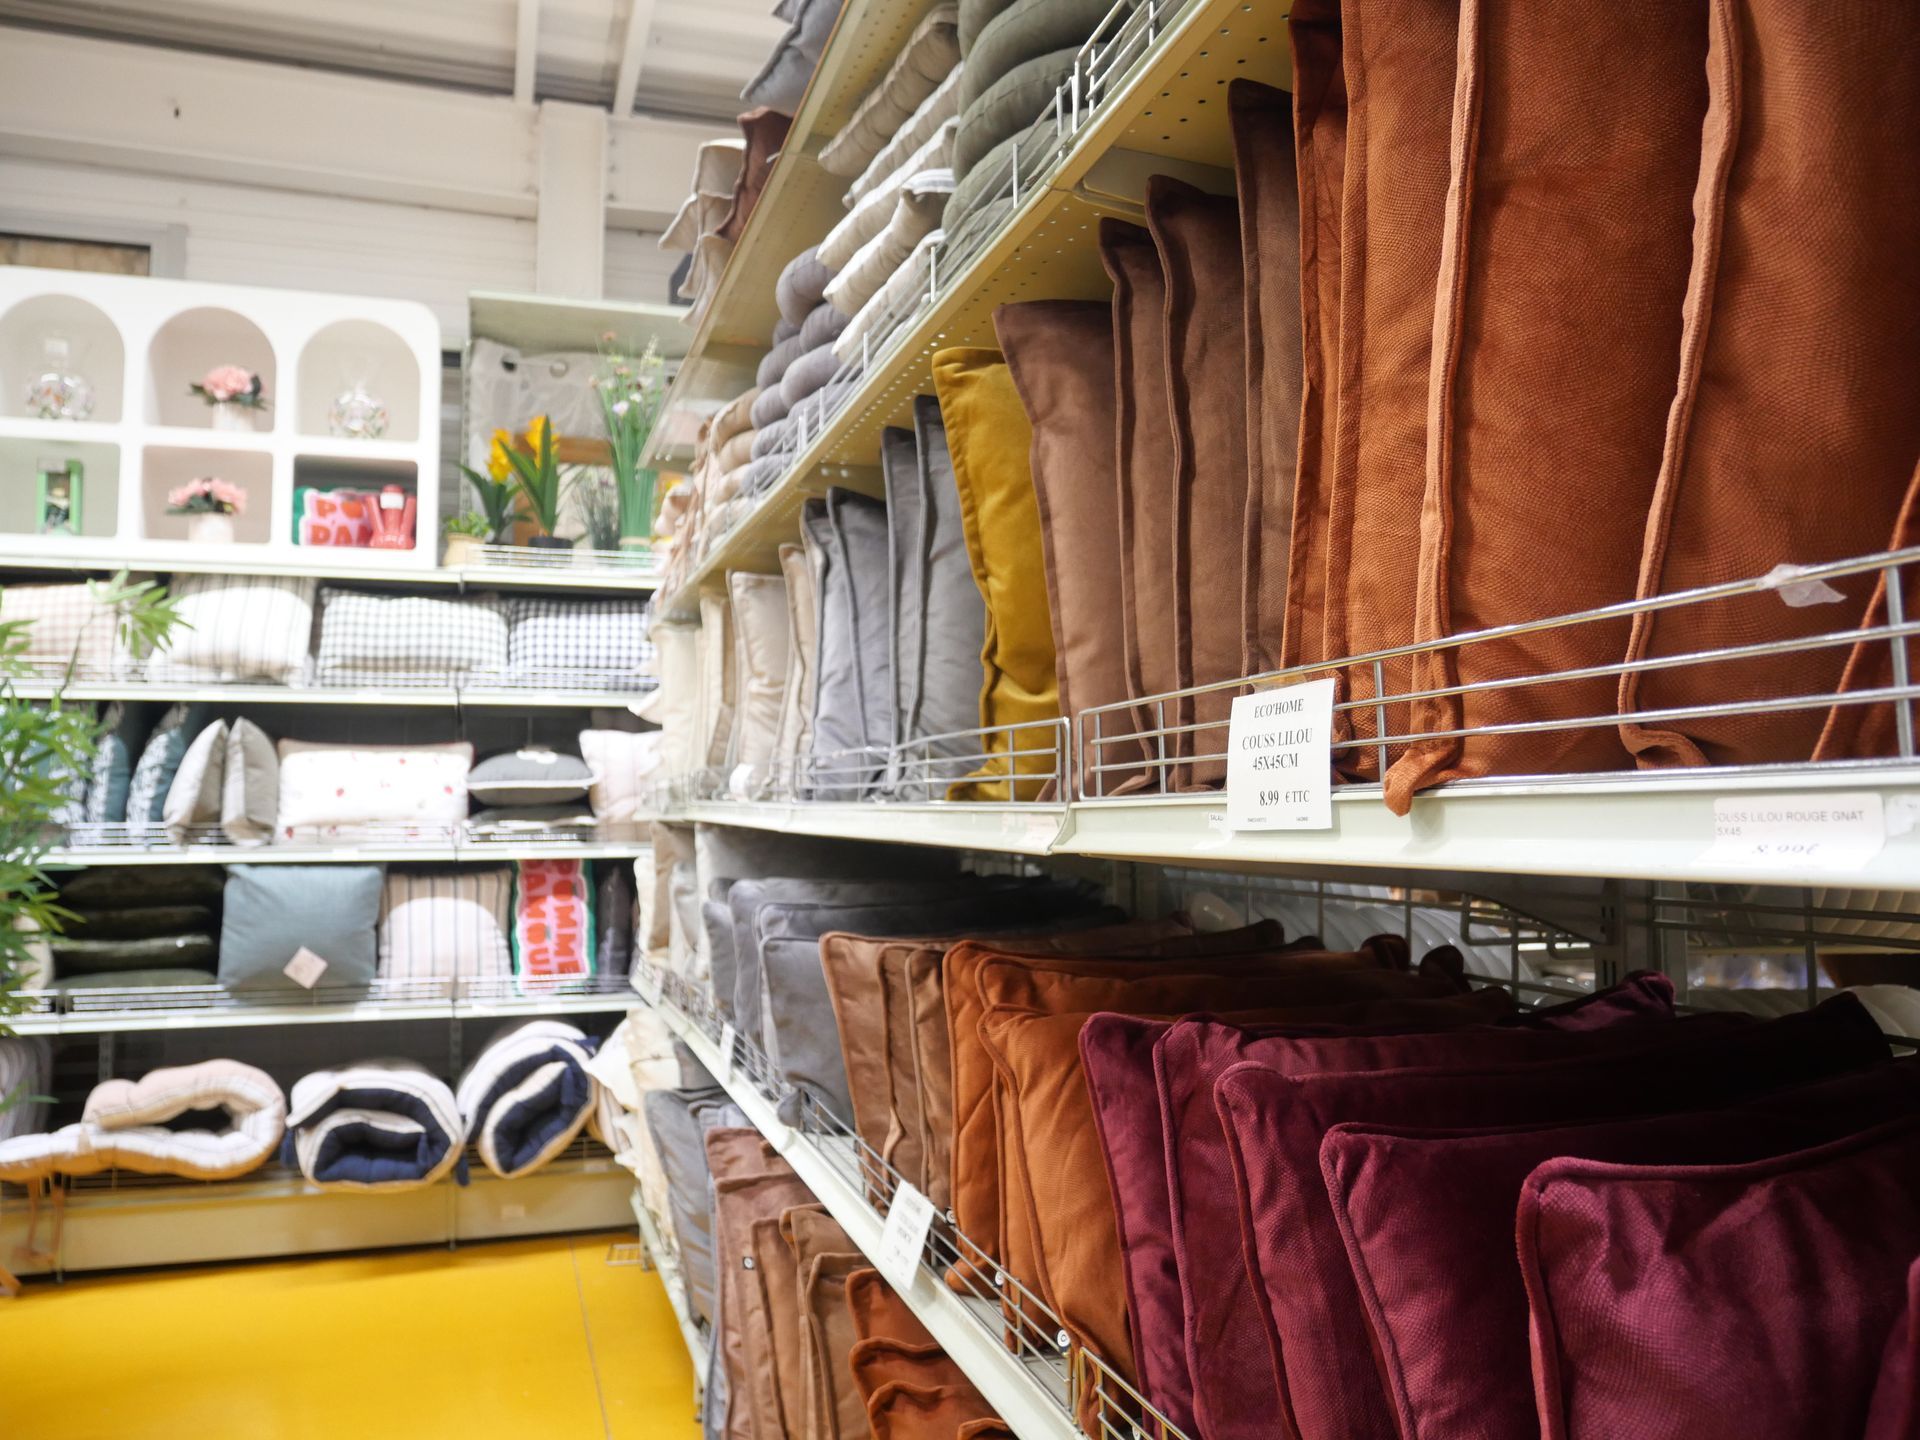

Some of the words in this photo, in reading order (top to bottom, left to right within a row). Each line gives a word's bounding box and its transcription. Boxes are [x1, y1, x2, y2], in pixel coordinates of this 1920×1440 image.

[1254, 699, 1304, 718] ECO'HOME
[1242, 732, 1275, 750] COUSS
[1278, 728, 1313, 747] LILOU
[1252, 753, 1299, 771] 45X45CM
[1259, 791, 1279, 807] 8.99
[1292, 790, 1310, 803] TTC
[1714, 812, 1747, 823] OUSS
[1750, 812, 1783, 823] LILOU
[1786, 811, 1828, 822] ROUGE
